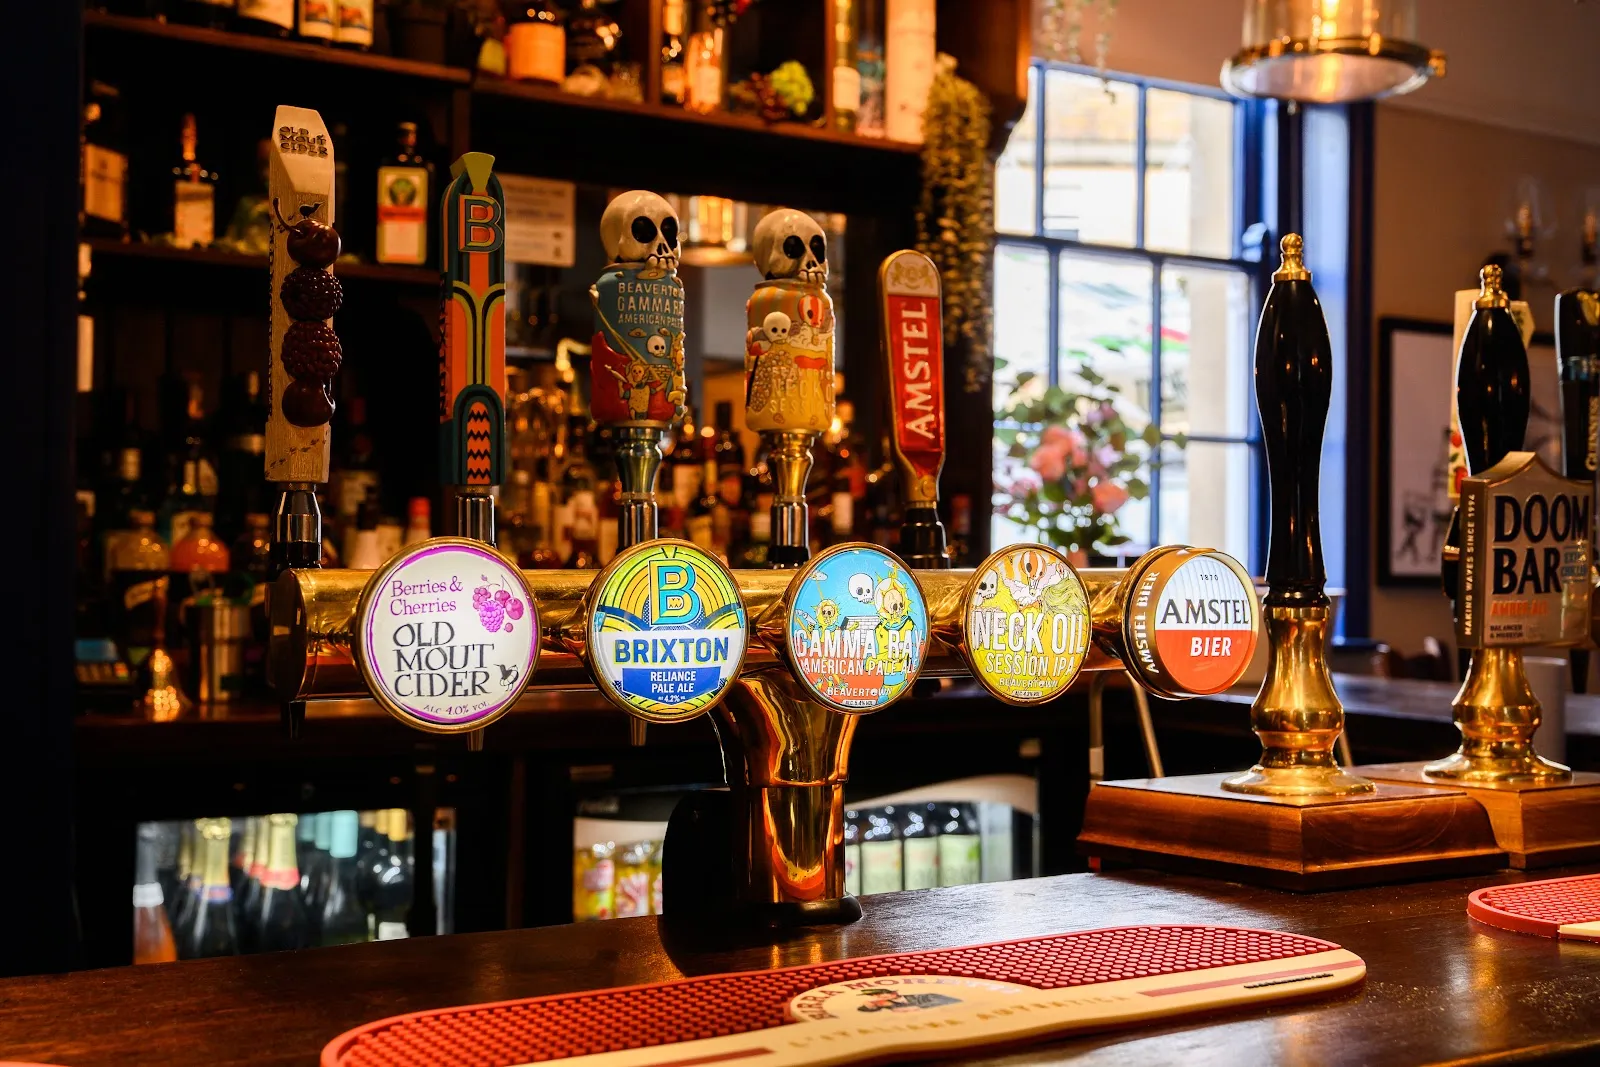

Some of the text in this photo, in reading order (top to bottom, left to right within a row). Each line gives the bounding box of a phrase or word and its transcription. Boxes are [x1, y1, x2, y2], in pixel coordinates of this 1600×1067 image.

[279, 126, 309, 136] OLD
[280, 134, 327, 146] MOUT
[281, 143, 328, 158] CIDER
[459, 194, 504, 253] B
[618, 282, 684, 299] BEAVERTO
[617, 296, 671, 314] GAMMA
[618, 313, 666, 326] AMERICAN
[905, 302, 935, 439] AMSTEL
[1493, 494, 1589, 543] DOOM
[1467, 522, 1475, 553] SINCE
[1465, 556, 1474, 592] WAVES
[1492, 547, 1562, 595] BAR
[391, 576, 463, 597] Berries &
[649, 559, 701, 626] B
[390, 598, 457, 616] Cherries
[1160, 599, 1249, 625] AMSTEL
[1464, 595, 1472, 636] MAKING
[393, 621, 455, 648] OLD
[972, 611, 1085, 655] NECK OIL
[1135, 571, 1160, 674] AMSTEL BIER
[614, 636, 729, 664] BRIXTON
[794, 629, 924, 659] GAMMA RAY
[1190, 636, 1232, 657] BIER
[392, 643, 495, 672] MOUT
[800, 658, 917, 676] AMERICAN PALE ALE
[986, 652, 1076, 677] SESSION IPA
[394, 670, 492, 698] CIDER
[650, 671, 697, 682] RELIANCE
[651, 682, 695, 693] PALE ALE
[1000, 677, 1059, 688] BEAVERTOWN
[827, 686, 893, 697] BEAVERTOWN
[446, 703, 469, 715] 4.0%
[797, 990, 845, 1020] BIRRA
